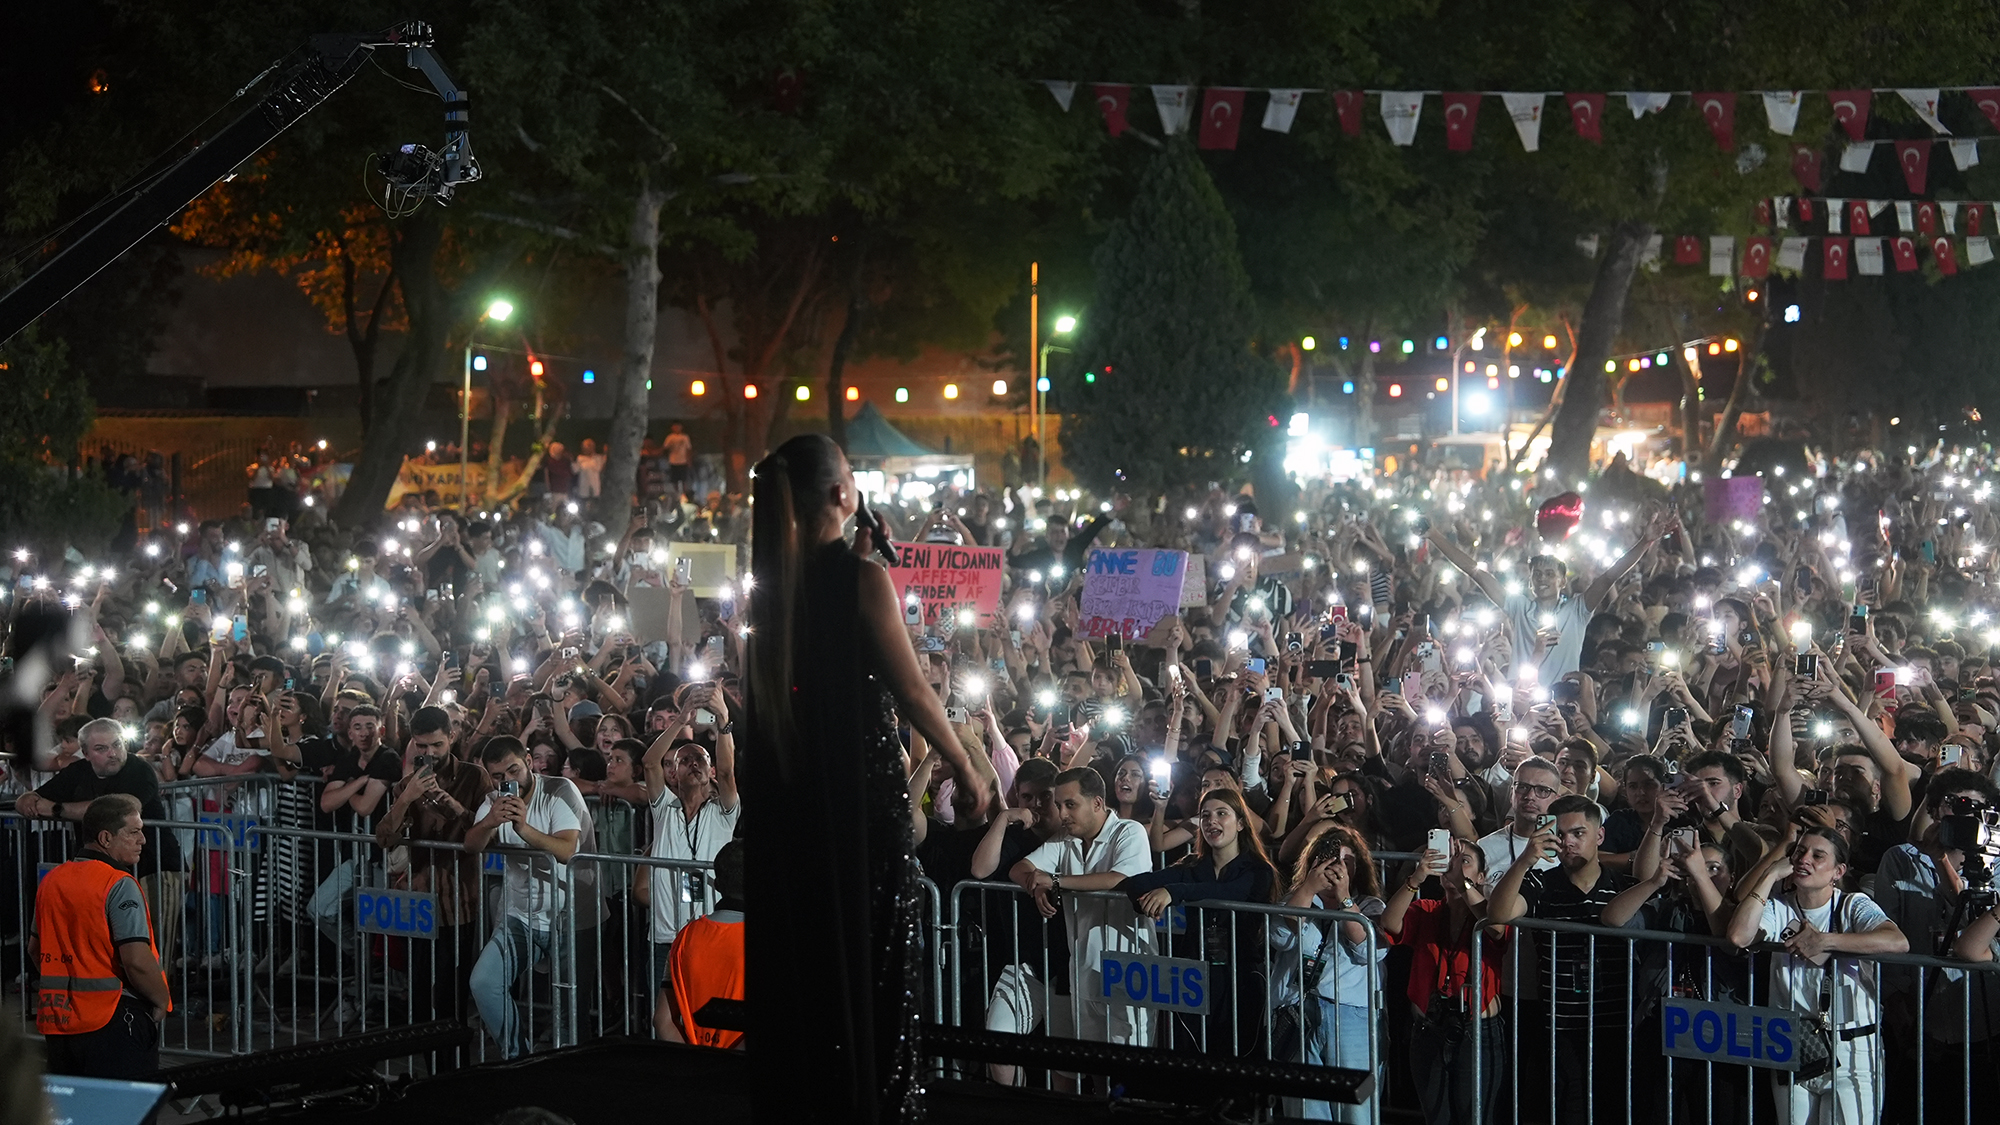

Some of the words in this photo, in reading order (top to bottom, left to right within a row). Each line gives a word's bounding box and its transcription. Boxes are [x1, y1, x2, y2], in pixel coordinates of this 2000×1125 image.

[1087, 550, 1138, 575] ANNE
[1151, 550, 1179, 576] BU
[1085, 576, 1141, 597] SEFER
